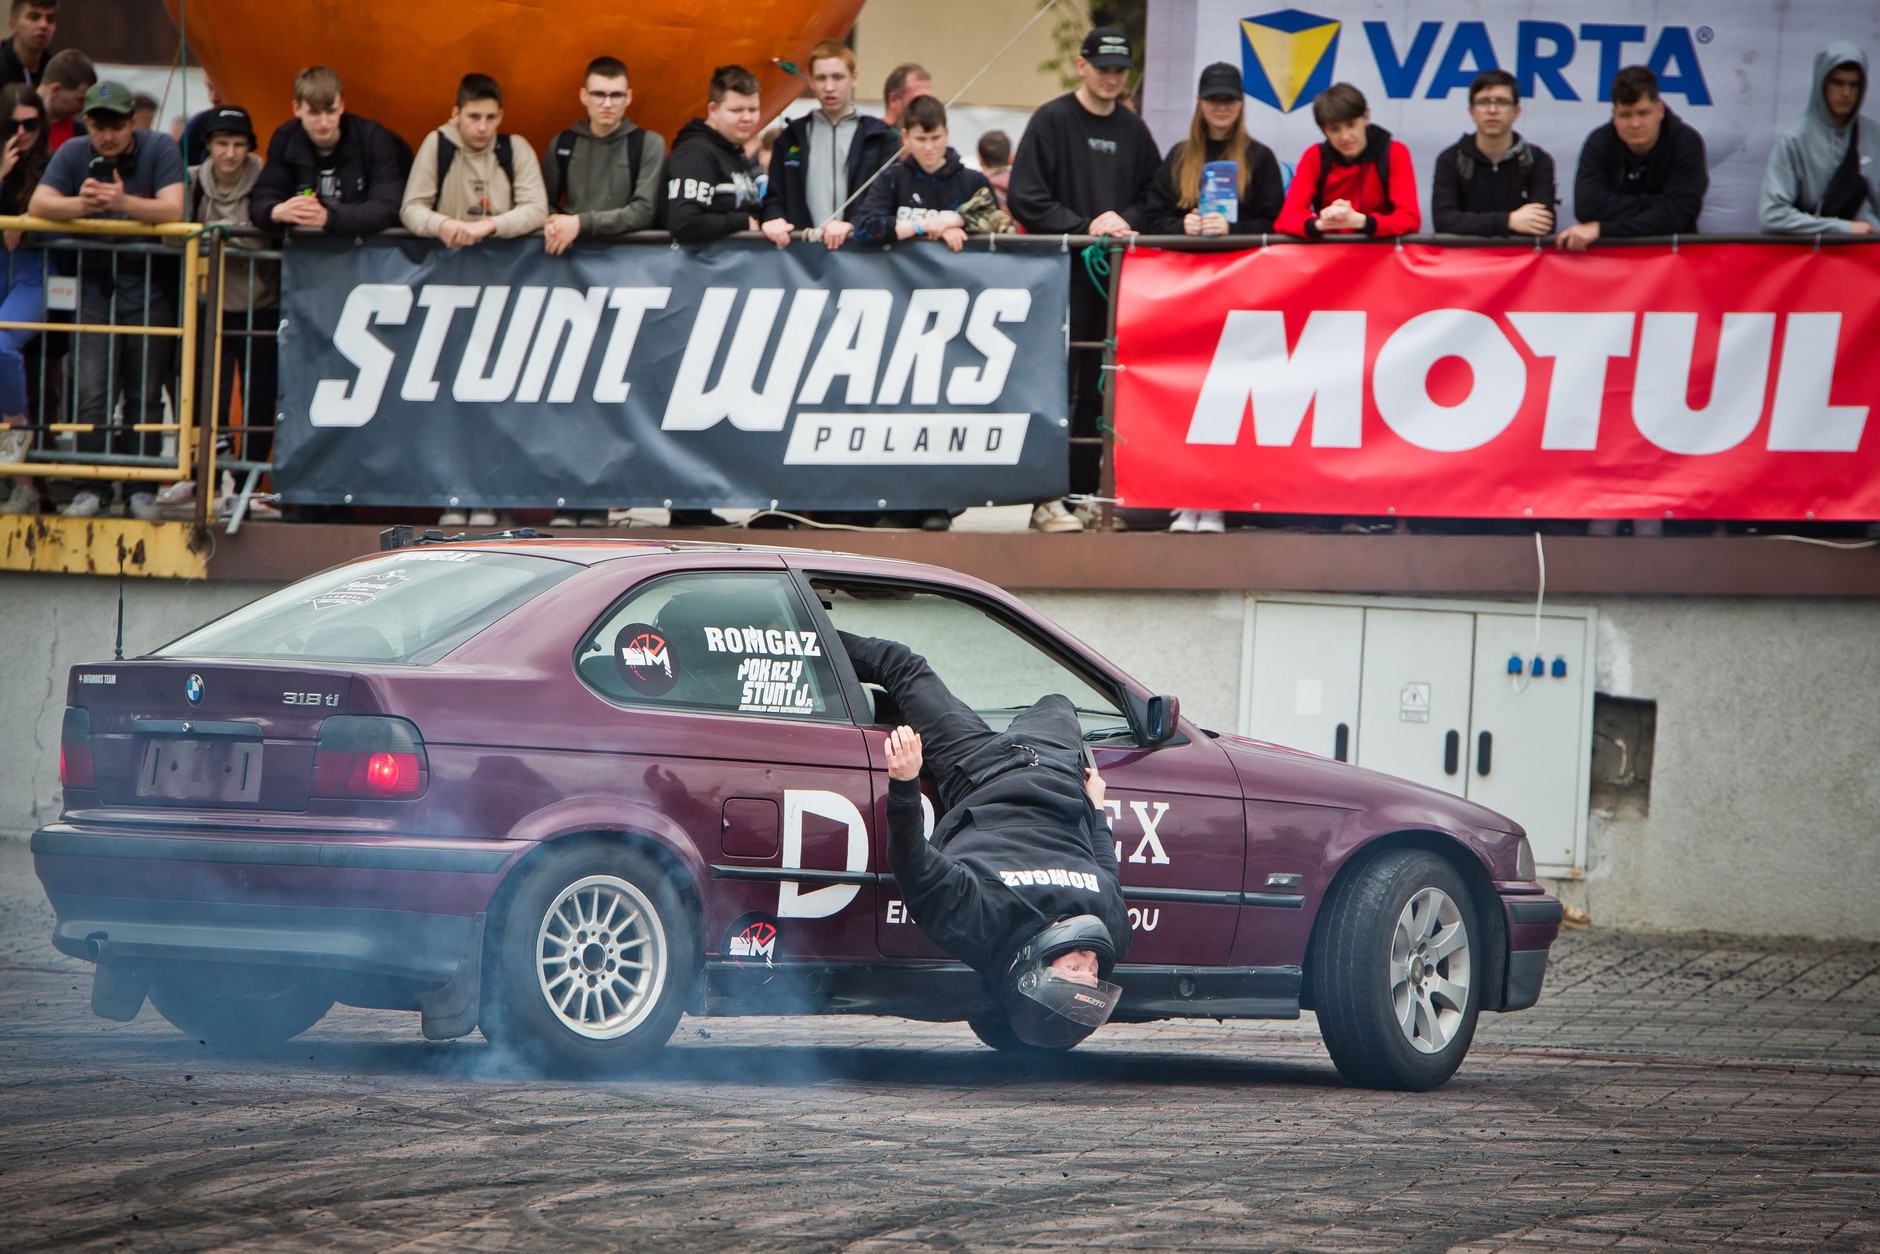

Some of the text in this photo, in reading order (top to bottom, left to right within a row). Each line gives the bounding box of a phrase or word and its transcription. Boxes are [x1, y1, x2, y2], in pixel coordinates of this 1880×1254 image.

[311, 284, 1031, 431] STUNT WARS
[1185, 308, 1869, 456] MOTUL
[814, 427, 1003, 453] POLAND
[704, 625, 821, 657] ROMGAZ
[104, 674, 117, 685] TEAM
[999, 869, 1100, 893] ROMGAZ
